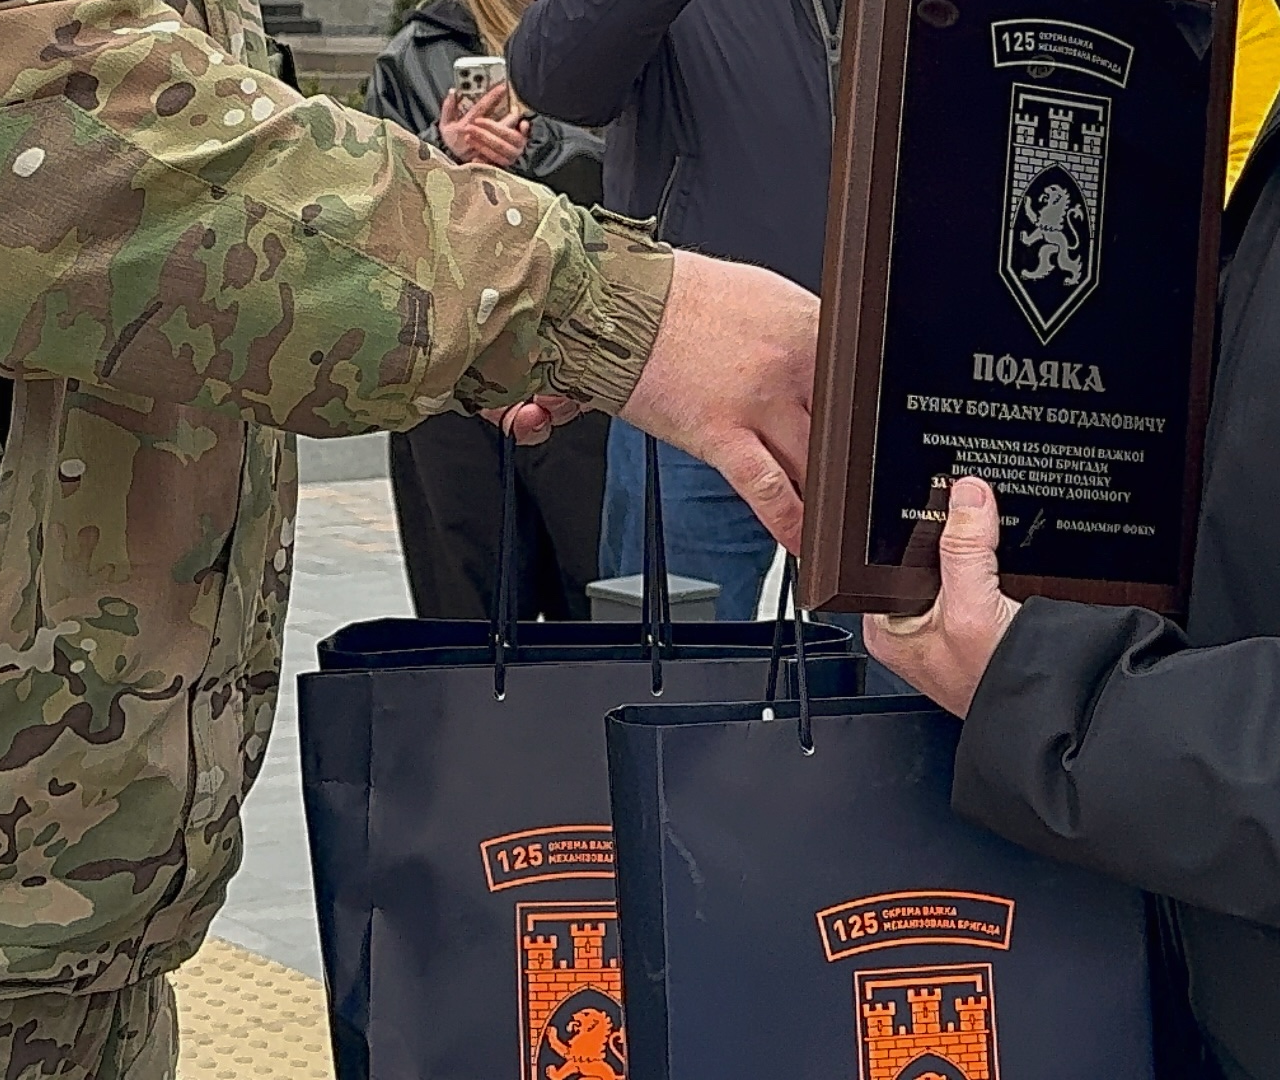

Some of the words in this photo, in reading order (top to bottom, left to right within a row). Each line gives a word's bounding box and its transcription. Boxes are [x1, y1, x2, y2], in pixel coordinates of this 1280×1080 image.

[1002, 31, 1035, 52] 125
[972, 353, 1106, 392] ПОДЯКА
[1022, 441, 1040, 453] 125
[1042, 444, 1096, 459] ОКРЕМОЇ
[1097, 449, 1145, 462] ВАЖКОЇ
[1055, 460, 1108, 474] БРИГАДИ
[1028, 471, 1064, 485] ЩИРУ
[1065, 474, 1112, 487] ПОДЯКУ
[931, 477, 946, 488] ЗА
[1066, 488, 1131, 503] ДОПОМОГУ
[901, 508, 947, 522] КОМАНД
[548, 841, 588, 852] ОКРЕМА
[497, 843, 543, 873] 125
[548, 853, 613, 864] МЕХАНІЗОВА
[881, 907, 921, 919] ОКРЕМА
[922, 906, 957, 917] ВАЖКА
[833, 911, 879, 942] 125
[958, 921, 1001, 936] БРИГАДА
